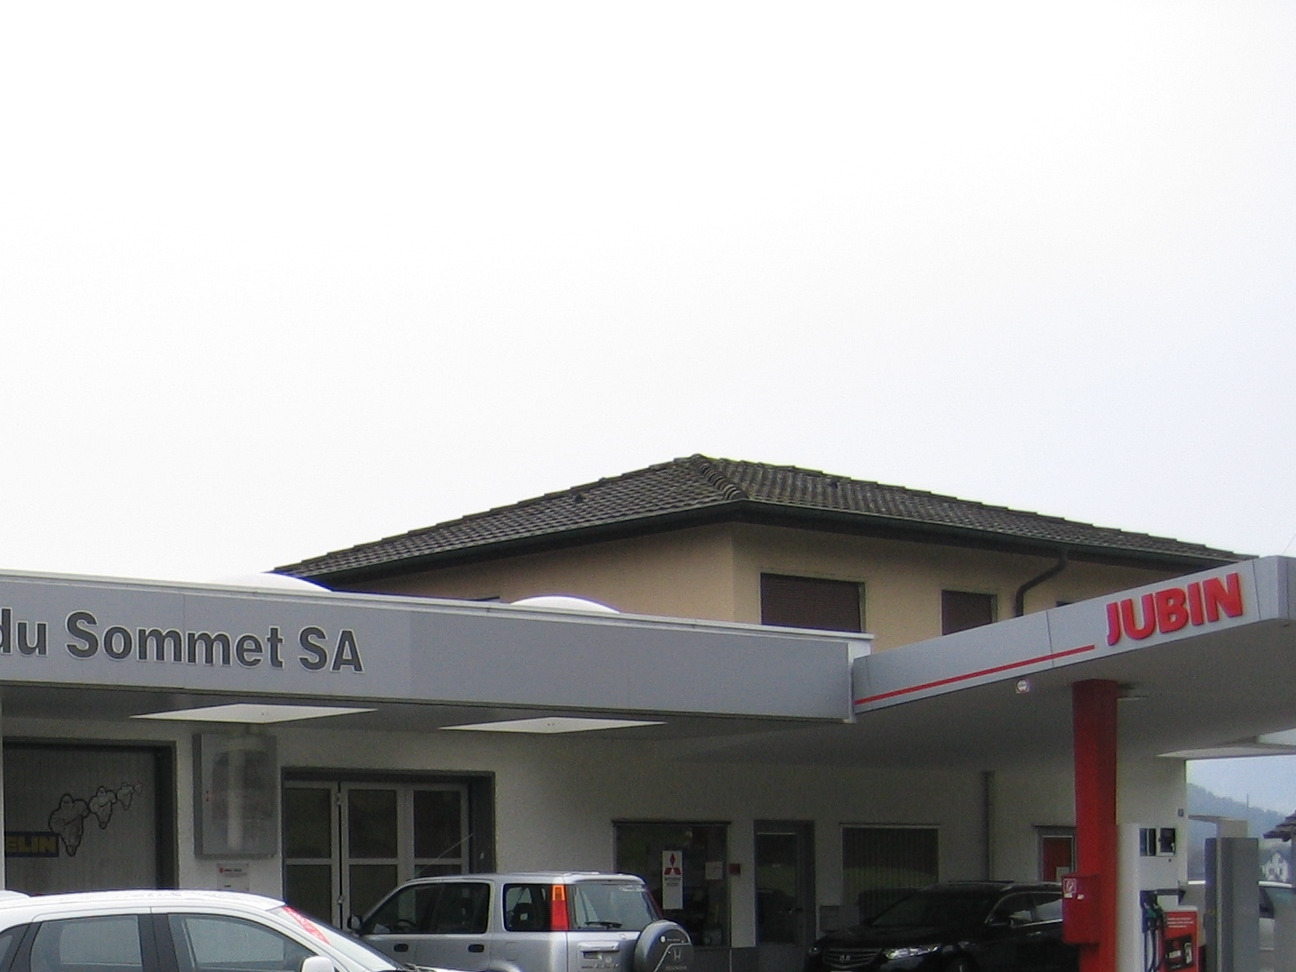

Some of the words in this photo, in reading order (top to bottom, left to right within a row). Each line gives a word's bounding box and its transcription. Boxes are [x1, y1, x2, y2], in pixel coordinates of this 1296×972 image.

[65, 610, 285, 669] Sommet
[298, 626, 365, 673] SA
[1106, 572, 1244, 646] JUBIN
